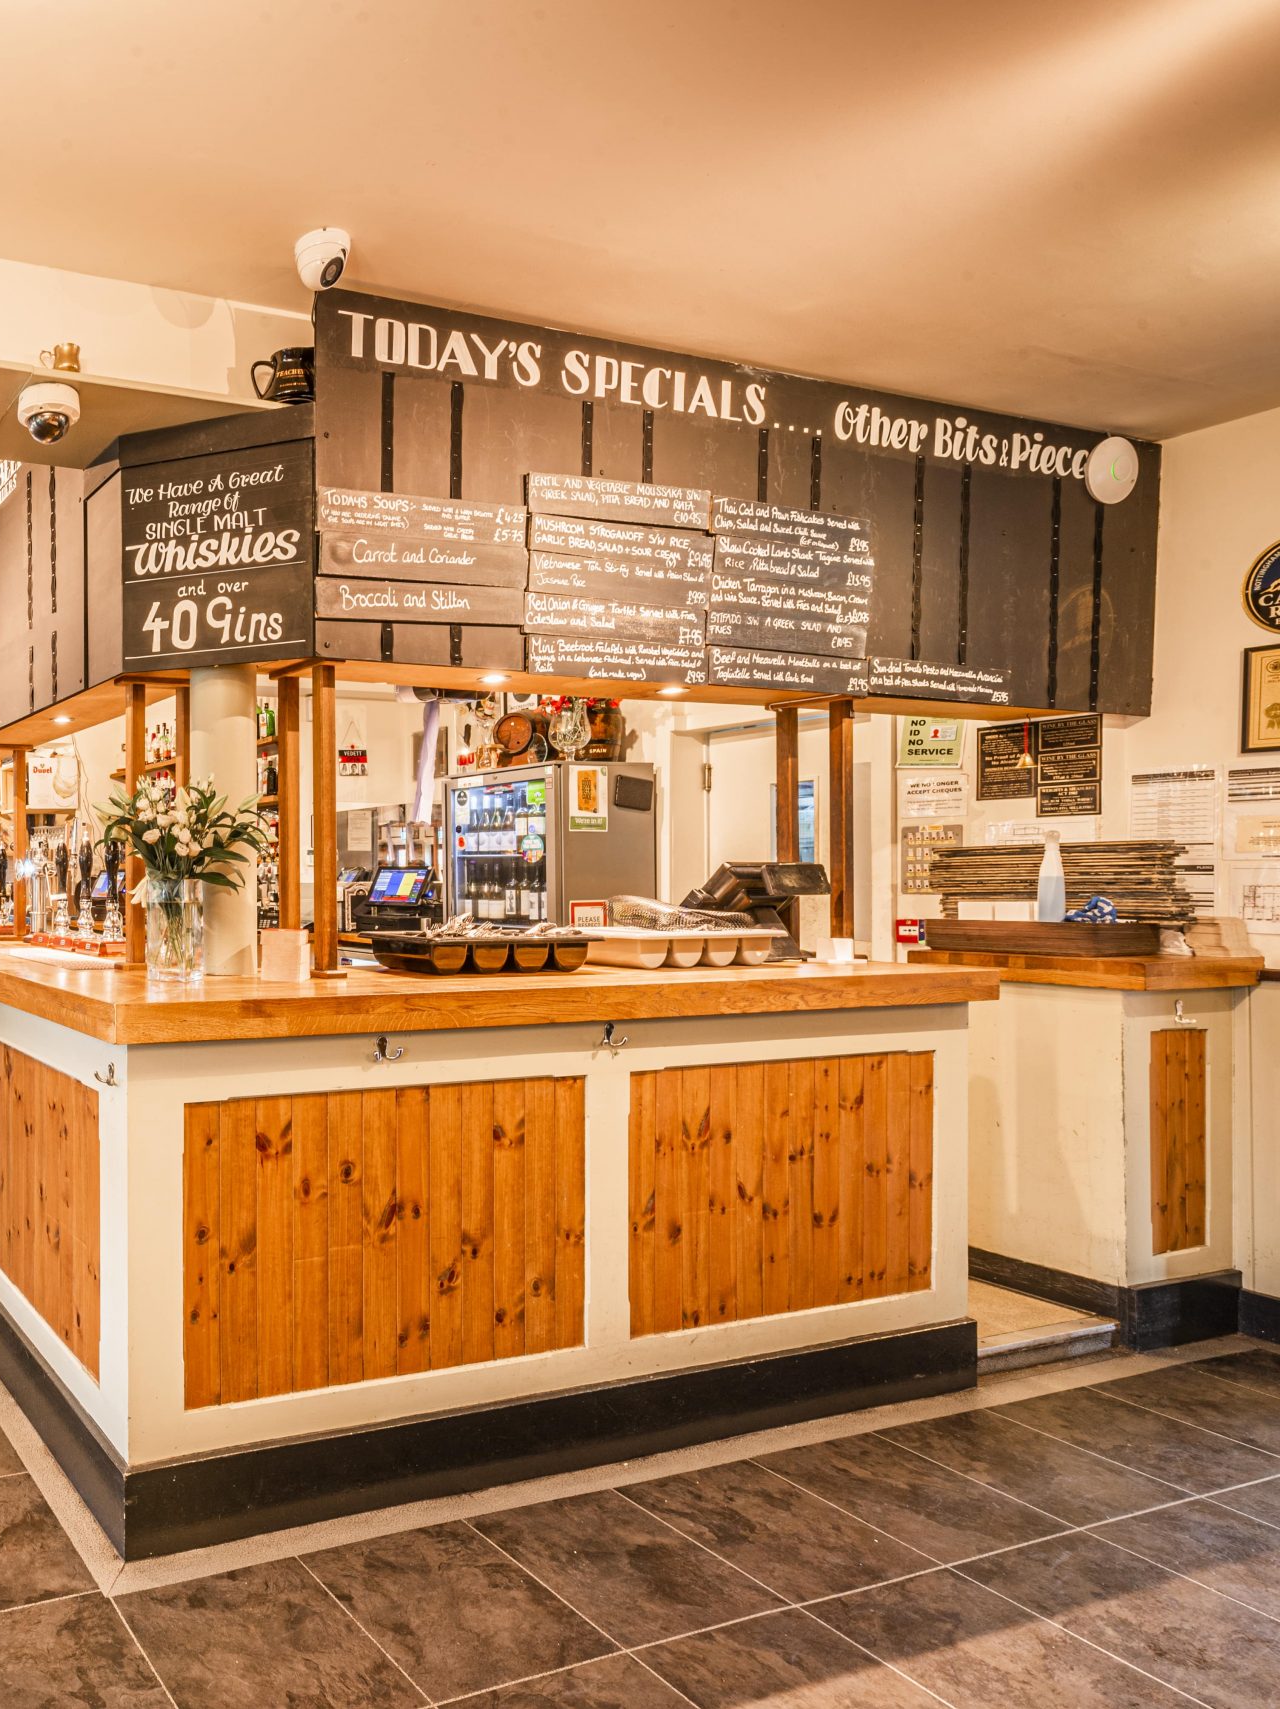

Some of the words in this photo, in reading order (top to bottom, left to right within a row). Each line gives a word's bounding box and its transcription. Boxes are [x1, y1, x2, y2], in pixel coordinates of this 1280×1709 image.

[338, 310, 541, 387] TODAY'S
[834, 401, 928, 453] Other
[934, 417, 998, 465] Bits
[999, 440, 1009, 468] &
[1010, 432, 1090, 480] Piece
[125, 488, 153, 504] We
[158, 480, 203, 500] Have
[208, 474, 224, 492] A
[229, 464, 284, 487] Great
[531, 475, 560, 486] LENTIL
[564, 478, 582, 489] AND
[637, 484, 682, 499] MOUSSAKA
[168, 498, 220, 518] Range
[324, 490, 367, 509] TODAYS
[531, 488, 537, 497] A
[624, 495, 650, 509] BREAD
[652, 498, 669, 509] AND
[145, 516, 207, 540] SINGLE
[214, 508, 268, 532] MALT
[714, 498, 737, 514] Thai
[739, 503, 753, 516] Cod
[756, 506, 769, 518] and
[772, 507, 789, 520] Prawn
[790, 511, 824, 524] Fishcakes
[827, 518, 846, 529] Served
[535, 517, 584, 534] MUSHROOM
[588, 524, 644, 542] STROGANOFF
[649, 534, 665, 545] S/W
[736, 518, 758, 531] Salad
[760, 522, 771, 533] and
[773, 523, 794, 535] Sweet
[125, 527, 301, 575] Whiskies
[353, 539, 398, 563] Carrot
[402, 548, 426, 563] and
[429, 548, 477, 565] Coriander
[535, 532, 565, 545] GARLIC
[632, 547, 652, 556] SOUR
[655, 550, 681, 560] CREAM
[720, 537, 741, 553] Slow
[743, 541, 769, 556] Cooked
[771, 545, 790, 558] Lamb
[815, 551, 841, 565] Tagine
[725, 558, 744, 569] Rice
[770, 560, 790, 575] bread
[796, 565, 819, 577] Salad
[178, 579, 206, 597] and
[217, 581, 249, 593] over
[340, 585, 399, 610] Broccoli
[404, 591, 427, 608] and
[431, 591, 470, 610] Stilton
[712, 575, 741, 590] Chicken
[743, 578, 779, 597] Tarragon
[781, 584, 788, 594] in
[789, 587, 795, 595] a
[528, 593, 547, 611] Red
[548, 598, 570, 611] Onion
[640, 607, 663, 618] Served
[711, 590, 723, 601] and
[761, 595, 782, 607] Served
[796, 600, 810, 610] Fries
[811, 602, 823, 613] and
[142, 599, 198, 652] 40
[206, 596, 283, 644] Gins
[526, 612, 567, 624] Coleslaw
[570, 615, 587, 627] and
[591, 616, 615, 629] Salad
[711, 612, 741, 624] STIFADO
[765, 617, 771, 626] A
[773, 619, 794, 630] GREEK
[801, 622, 821, 632] SALAD
[827, 625, 841, 633] AND
[532, 637, 555, 653] Mini
[557, 639, 594, 651] Beetroot
[691, 649, 704, 658] and
[558, 653, 565, 661] in
[713, 649, 736, 664] Beef
[737, 653, 751, 664] and
[714, 666, 750, 682] Tagliatelle
[753, 669, 771, 679] Served
